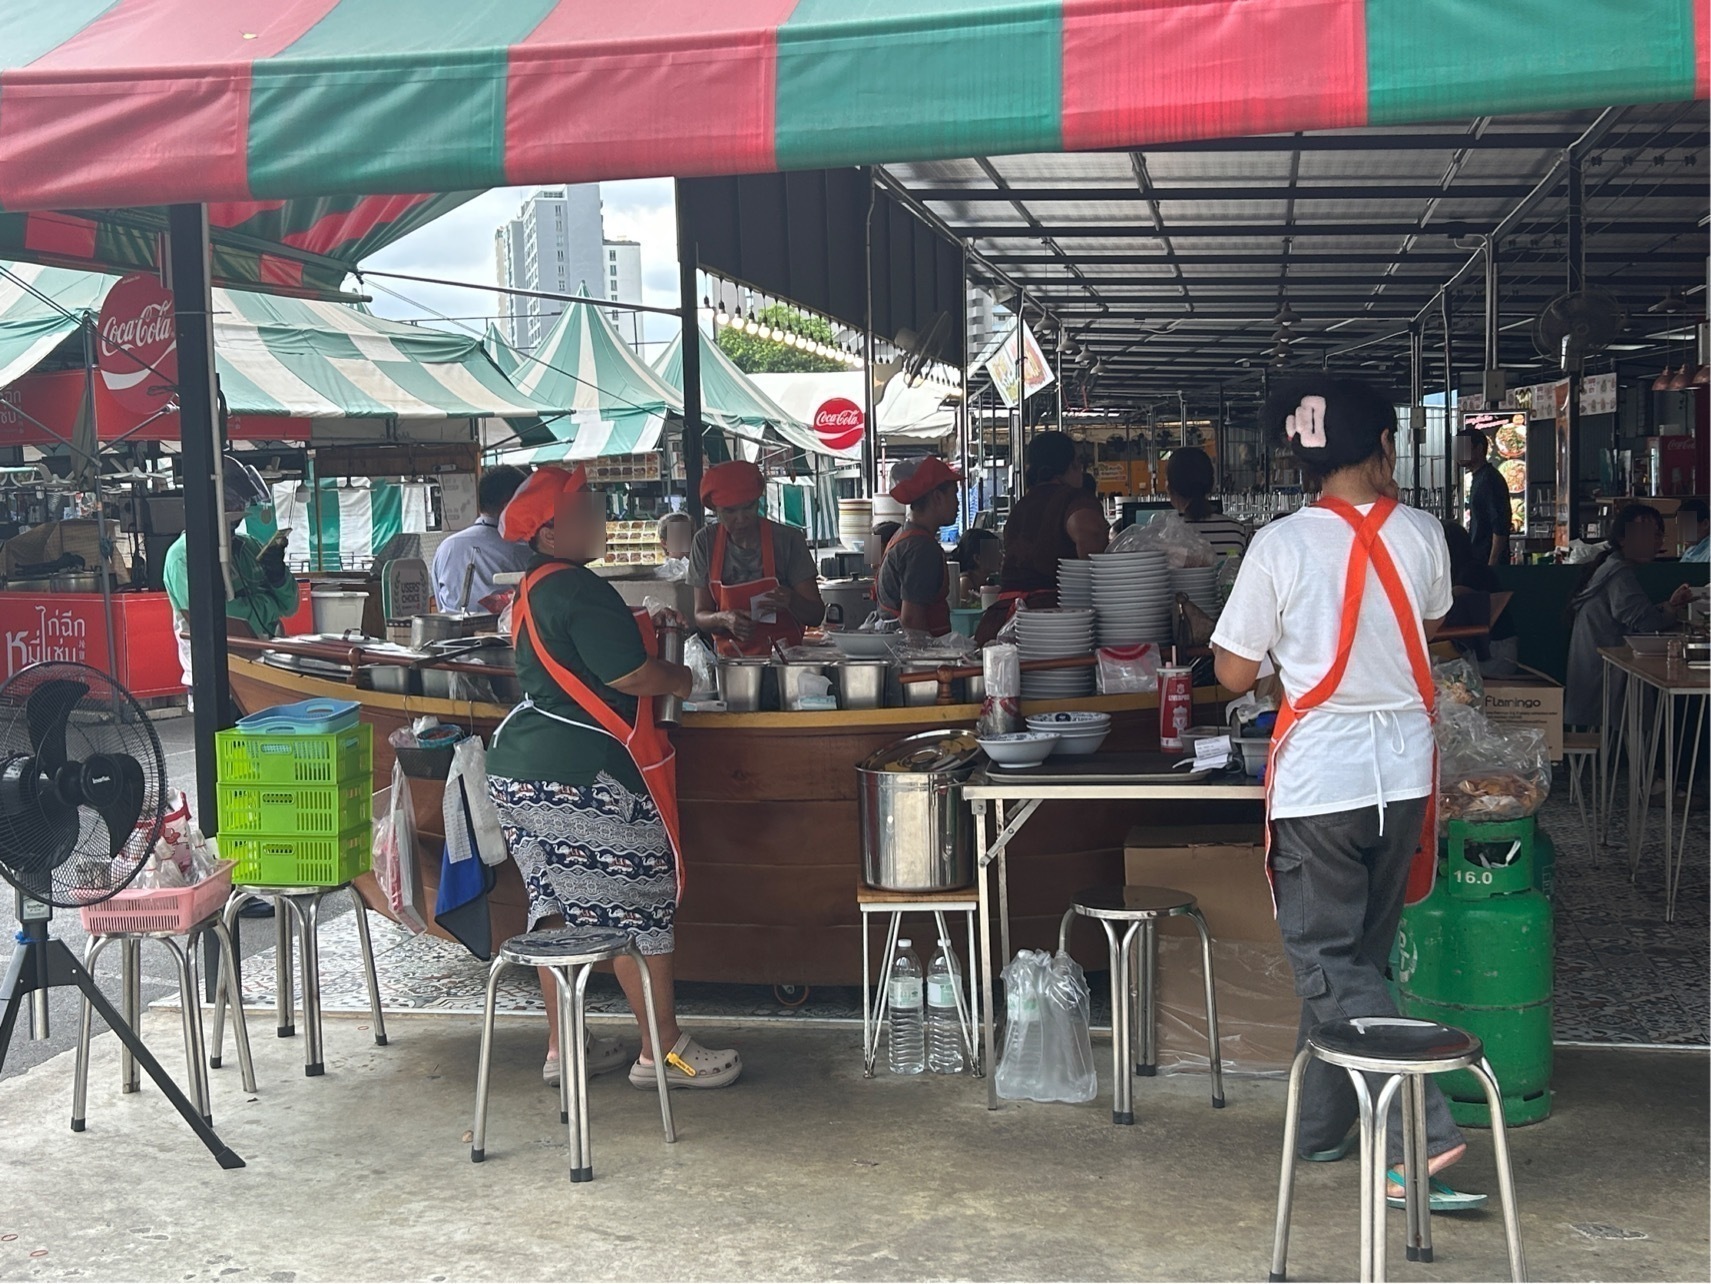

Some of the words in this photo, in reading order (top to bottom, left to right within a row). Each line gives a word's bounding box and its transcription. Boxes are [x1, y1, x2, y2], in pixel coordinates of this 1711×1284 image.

[101, 299, 173, 357] Coca-Cola
[816, 409, 860, 427] Coca-Cola
[1453, 870, 1493, 885] 16.0
